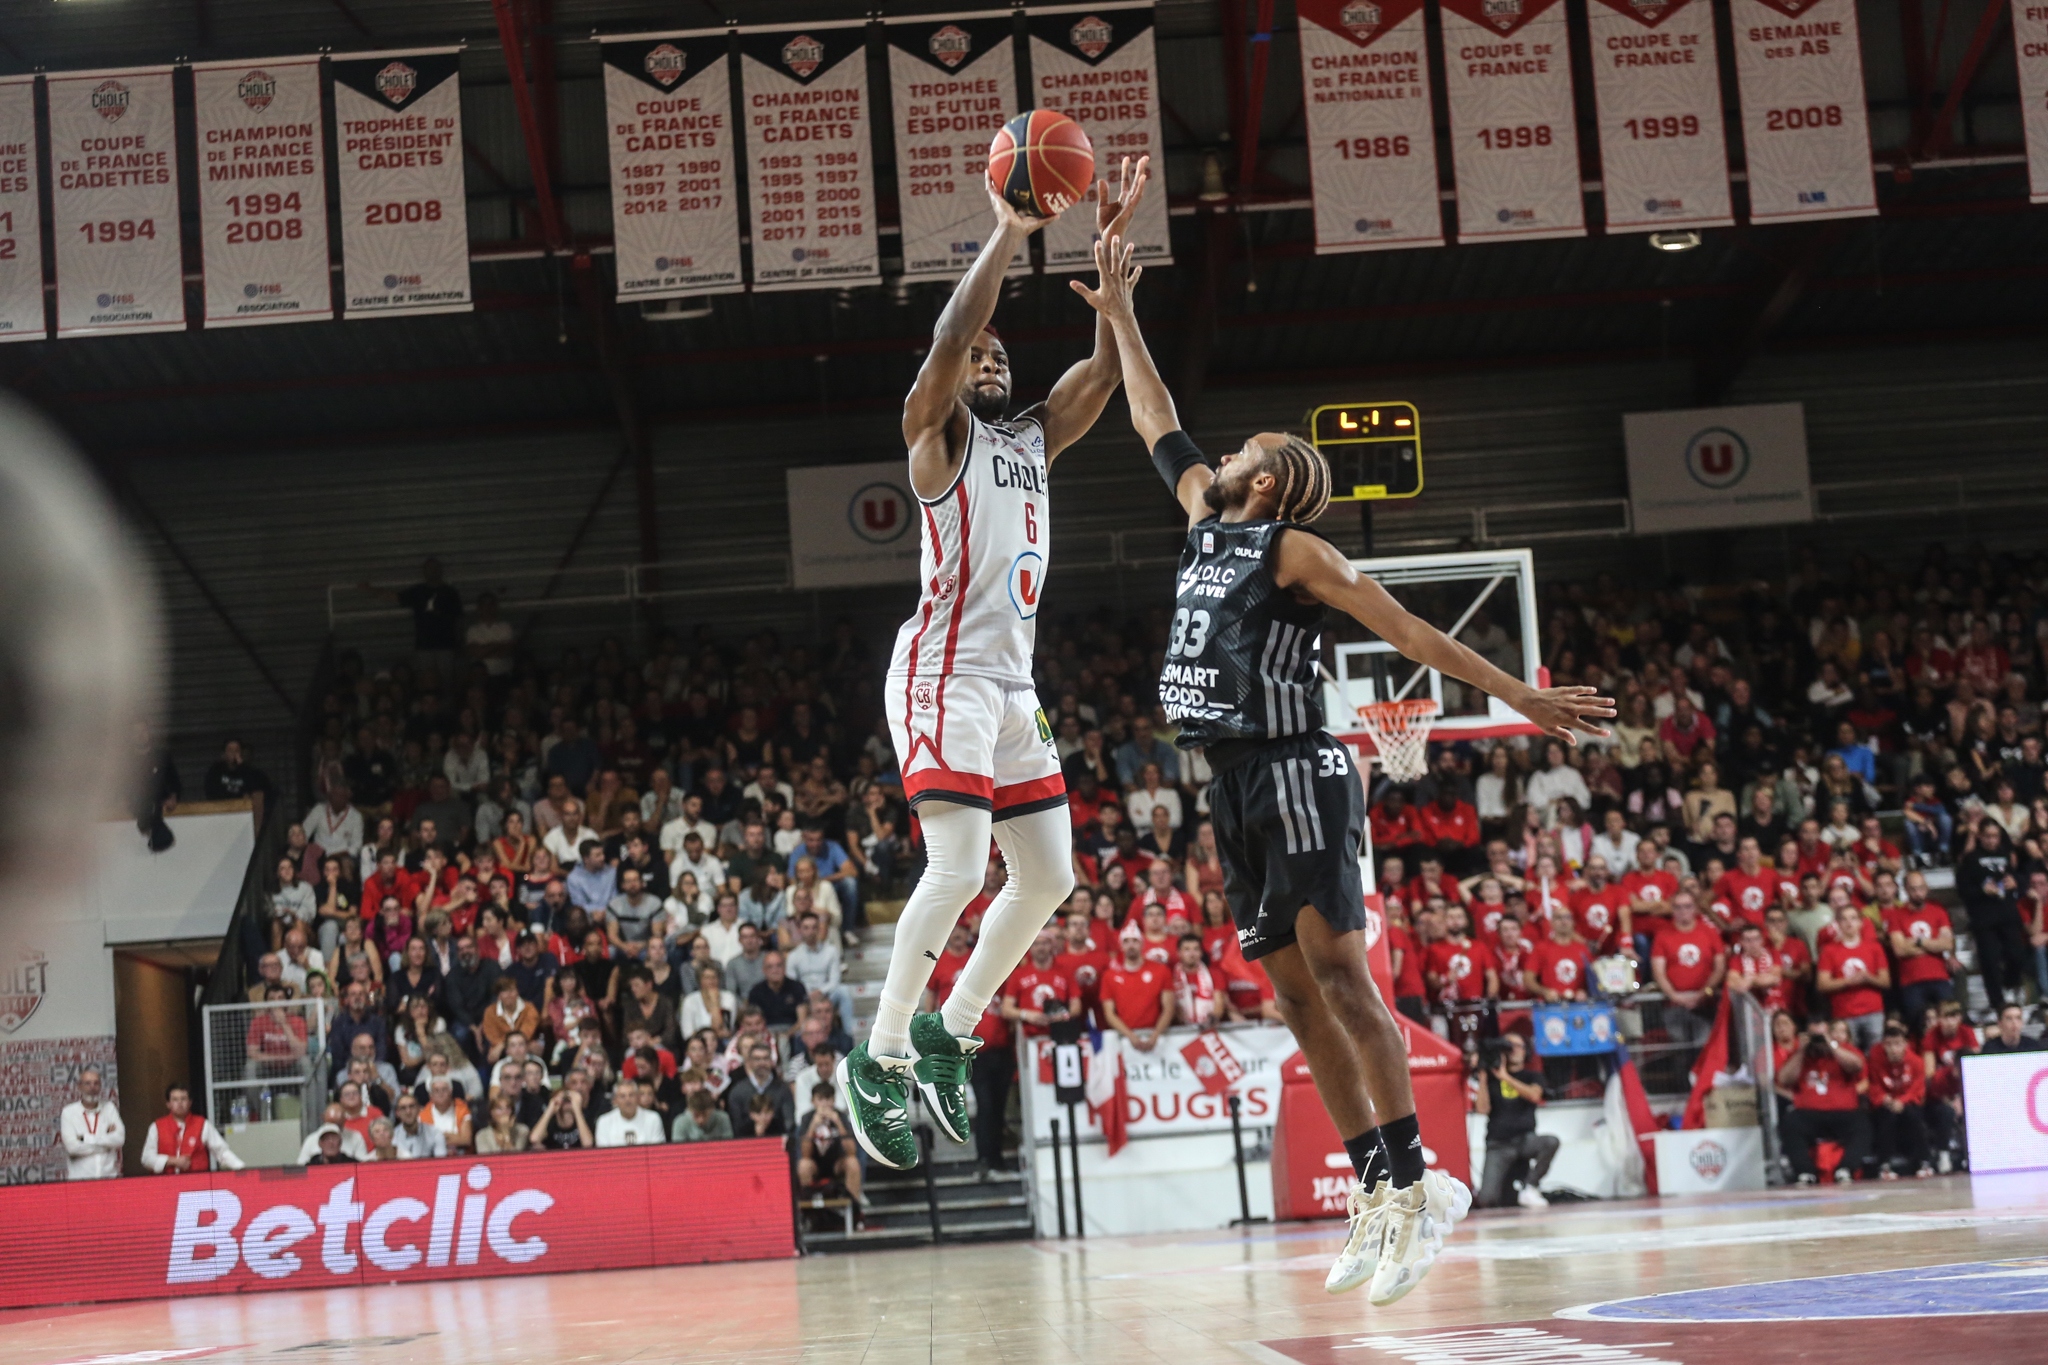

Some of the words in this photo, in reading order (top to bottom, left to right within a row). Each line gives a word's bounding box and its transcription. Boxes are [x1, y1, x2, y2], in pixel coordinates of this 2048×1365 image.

[1606, 33, 1673, 51] COUPE
[1679, 34, 1700, 46] DE
[1748, 21, 1843, 43] SEMAINE
[1460, 43, 1526, 61] COUPE
[1533, 43, 1554, 56] DE
[1614, 49, 1696, 69] FRANCE
[1765, 44, 1796, 60] DES
[1799, 39, 1831, 57] AS
[1311, 51, 1419, 71] CHAMPION
[1467, 59, 1550, 79] FRANCE
[908, 78, 999, 99] TROPHÉE
[1041, 69, 1149, 90] CHAMPION
[1313, 77, 1333, 89] DE
[1338, 69, 1420, 87] FRANCE
[752, 88, 861, 108] CHAMPION
[1043, 97, 1063, 108] DE
[1069, 86, 1150, 106] FRANCE
[1314, 86, 1405, 104] NATIONALE
[636, 98, 702, 116] COUPE
[753, 114, 774, 127] DE
[780, 106, 861, 125] FRANCE
[909, 105, 931, 117] DU
[936, 96, 1002, 114] FUTUR
[1064, 104, 1148, 122] SPOIRS
[343, 115, 427, 137] TROPHÉE
[434, 117, 455, 130] DU
[616, 123, 636, 136] DE
[642, 114, 724, 132] FRANCE
[907, 113, 1006, 135] ESPOIRS
[1623, 114, 1700, 141] 1999
[1765, 104, 1843, 132] 2008
[206, 122, 314, 144] CHAMPION
[346, 131, 454, 153] PRÉSIDENT
[625, 131, 717, 153] CADETS
[763, 123, 854, 144] CADETS
[1476, 124, 1553, 151] 1998
[81, 135, 145, 153] COUPE
[207, 149, 227, 163] DE
[233, 140, 315, 161] FRANCE
[1334, 135, 1411, 160] 1986
[61, 159, 81, 172] DE
[86, 151, 167, 171] FRANCE
[358, 150, 444, 171] CADETS
[814, 151, 859, 167] 1994
[909, 164, 953, 179] 2001
[964, 160, 989, 174] 20
[59, 170, 170, 191] CADETTES
[208, 159, 315, 182] MINIMES
[621, 164, 665, 180] 1987
[815, 169, 859, 185] 1997
[623, 181, 666, 197] 1997
[677, 177, 722, 194] 2001
[816, 187, 861, 203] 2000
[910, 181, 955, 196] 2019
[225, 191, 302, 218] 1994
[364, 200, 442, 227] 2008
[623, 199, 668, 216] 2012
[679, 195, 722, 212] 2017
[761, 208, 806, 224] 2001
[79, 219, 156, 244] 1994
[226, 218, 304, 245] 2008
[762, 226, 806, 242] 2017
[1700, 444, 1734, 476] U
[863, 499, 897, 532] U
[1024, 502, 1038, 545] 6
[1234, 546, 1263, 560] OLPLAY
[1169, 606, 1212, 659] 33
[1162, 663, 1220, 688] SMART
[1158, 683, 1206, 707] GOOD
[1162, 703, 1224, 724] HINGS
[1317, 747, 1349, 777] 33
[1129, 1059, 1151, 1081] at
[1160, 1058, 1182, 1080] le
[1124, 1086, 1269, 1123] OUGES
[166, 1163, 556, 1284] Betclic
